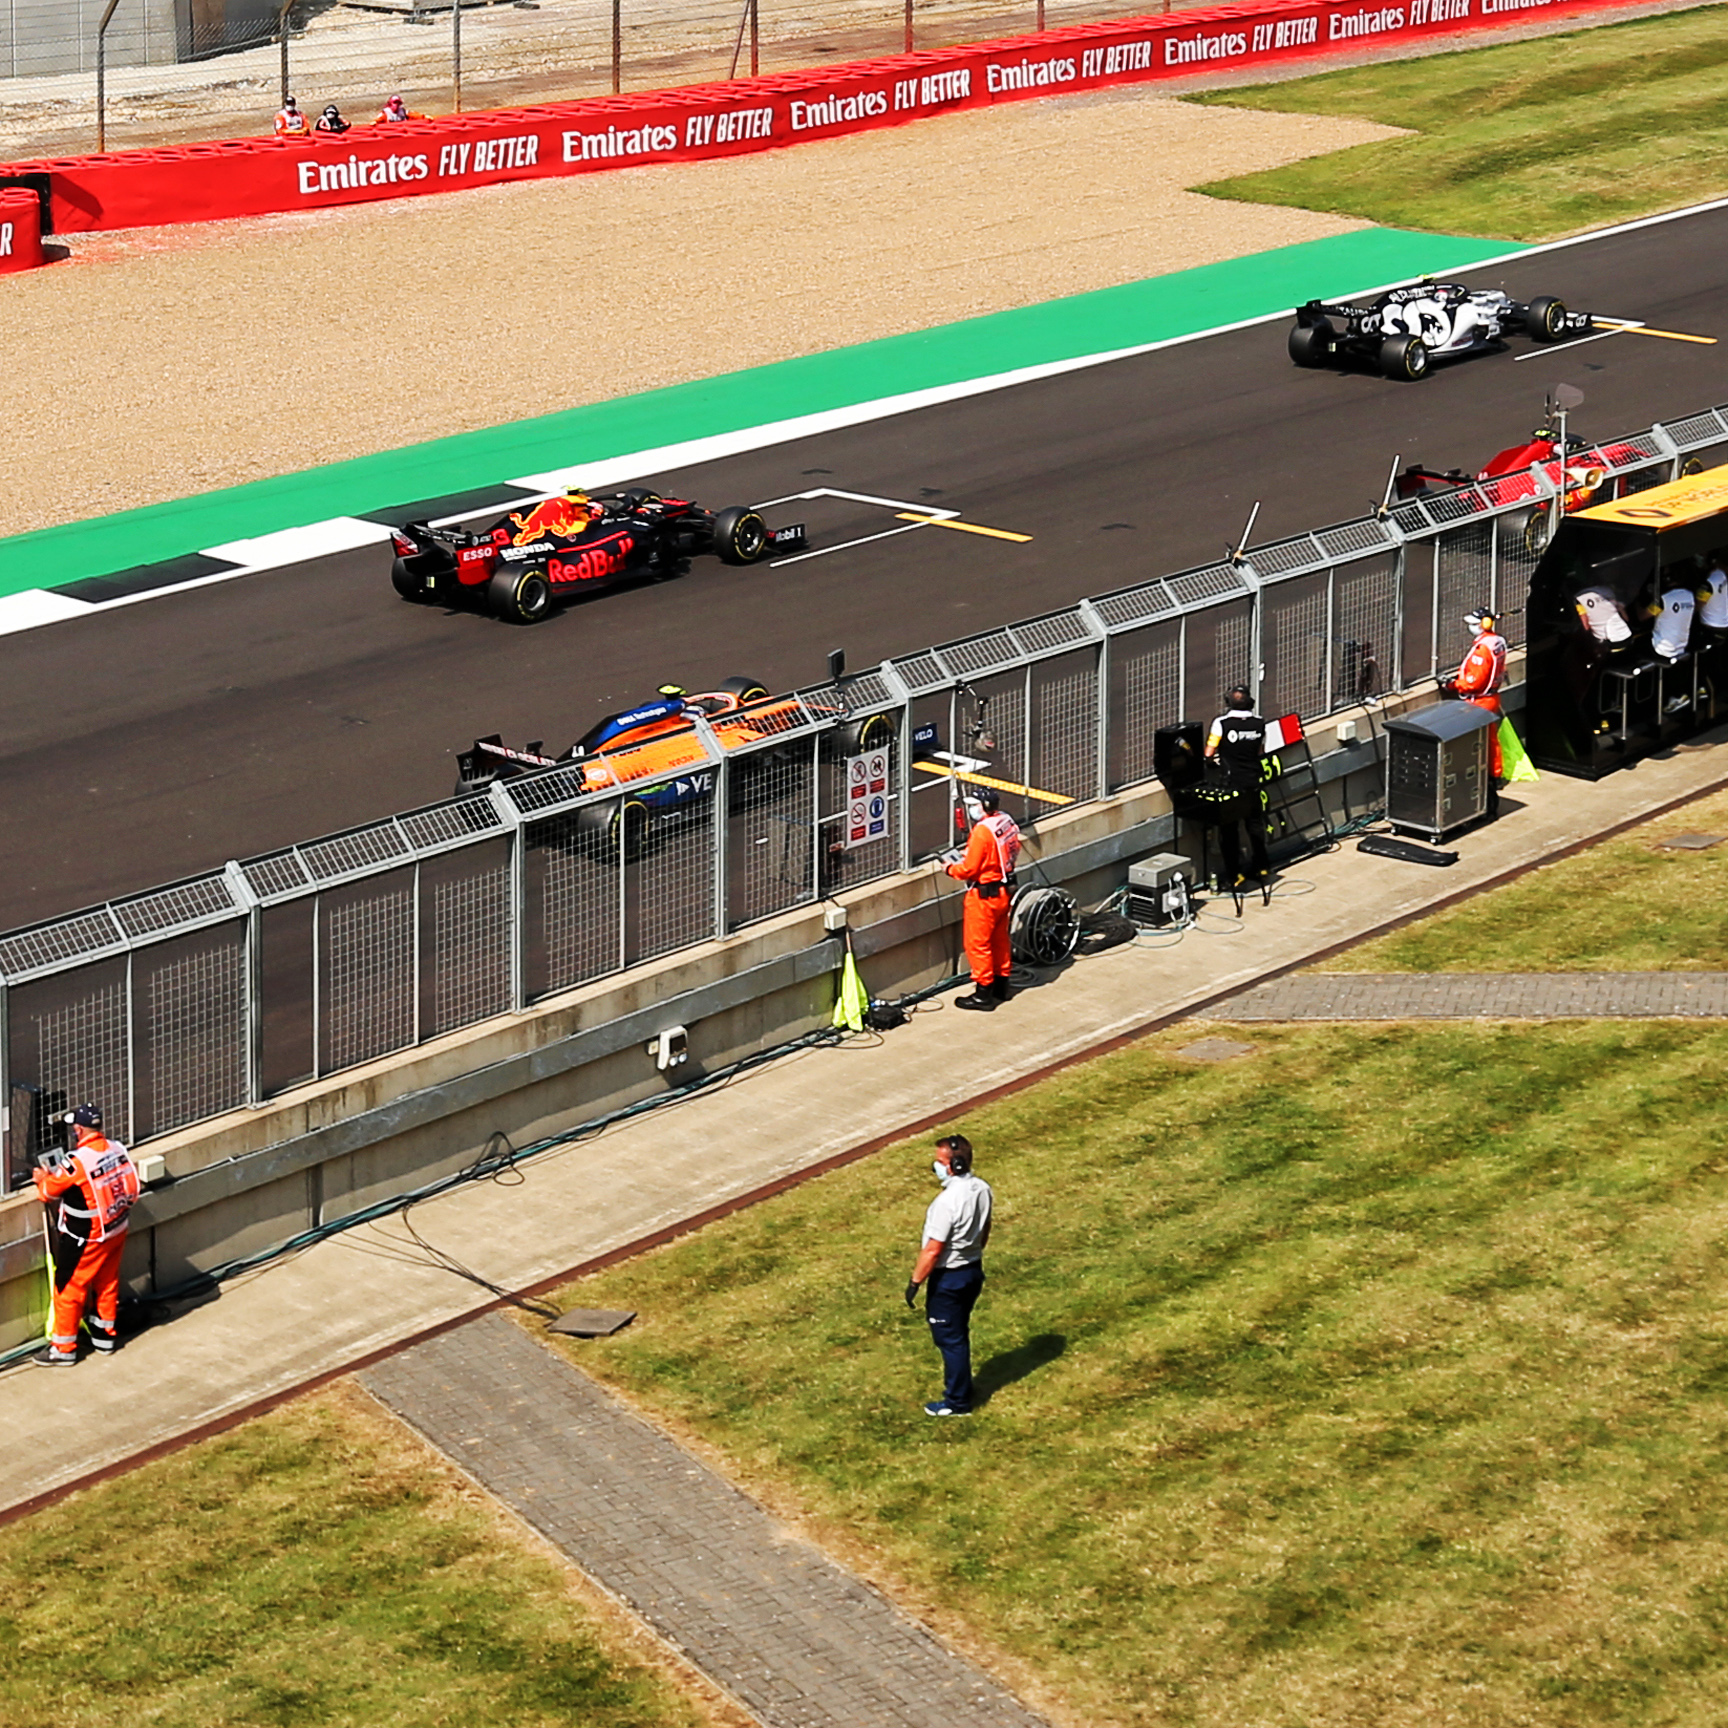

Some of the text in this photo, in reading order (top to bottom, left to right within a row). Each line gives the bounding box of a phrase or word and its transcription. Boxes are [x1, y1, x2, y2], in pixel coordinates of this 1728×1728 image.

[1164, 16, 1318, 66] Emirates FLY BETTER
[1329, 7, 1405, 41] Emirates
[986, 40, 1153, 94] Emirates FLY BETTER
[790, 68, 970, 129] Emirates FLY BETTER
[562, 107, 773, 167] Emirates FLY BETTER
[297, 134, 539, 199] Emirates FLY BETTER
[462, 547, 493, 562] ESSO
[500, 542, 556, 559] HONDA
